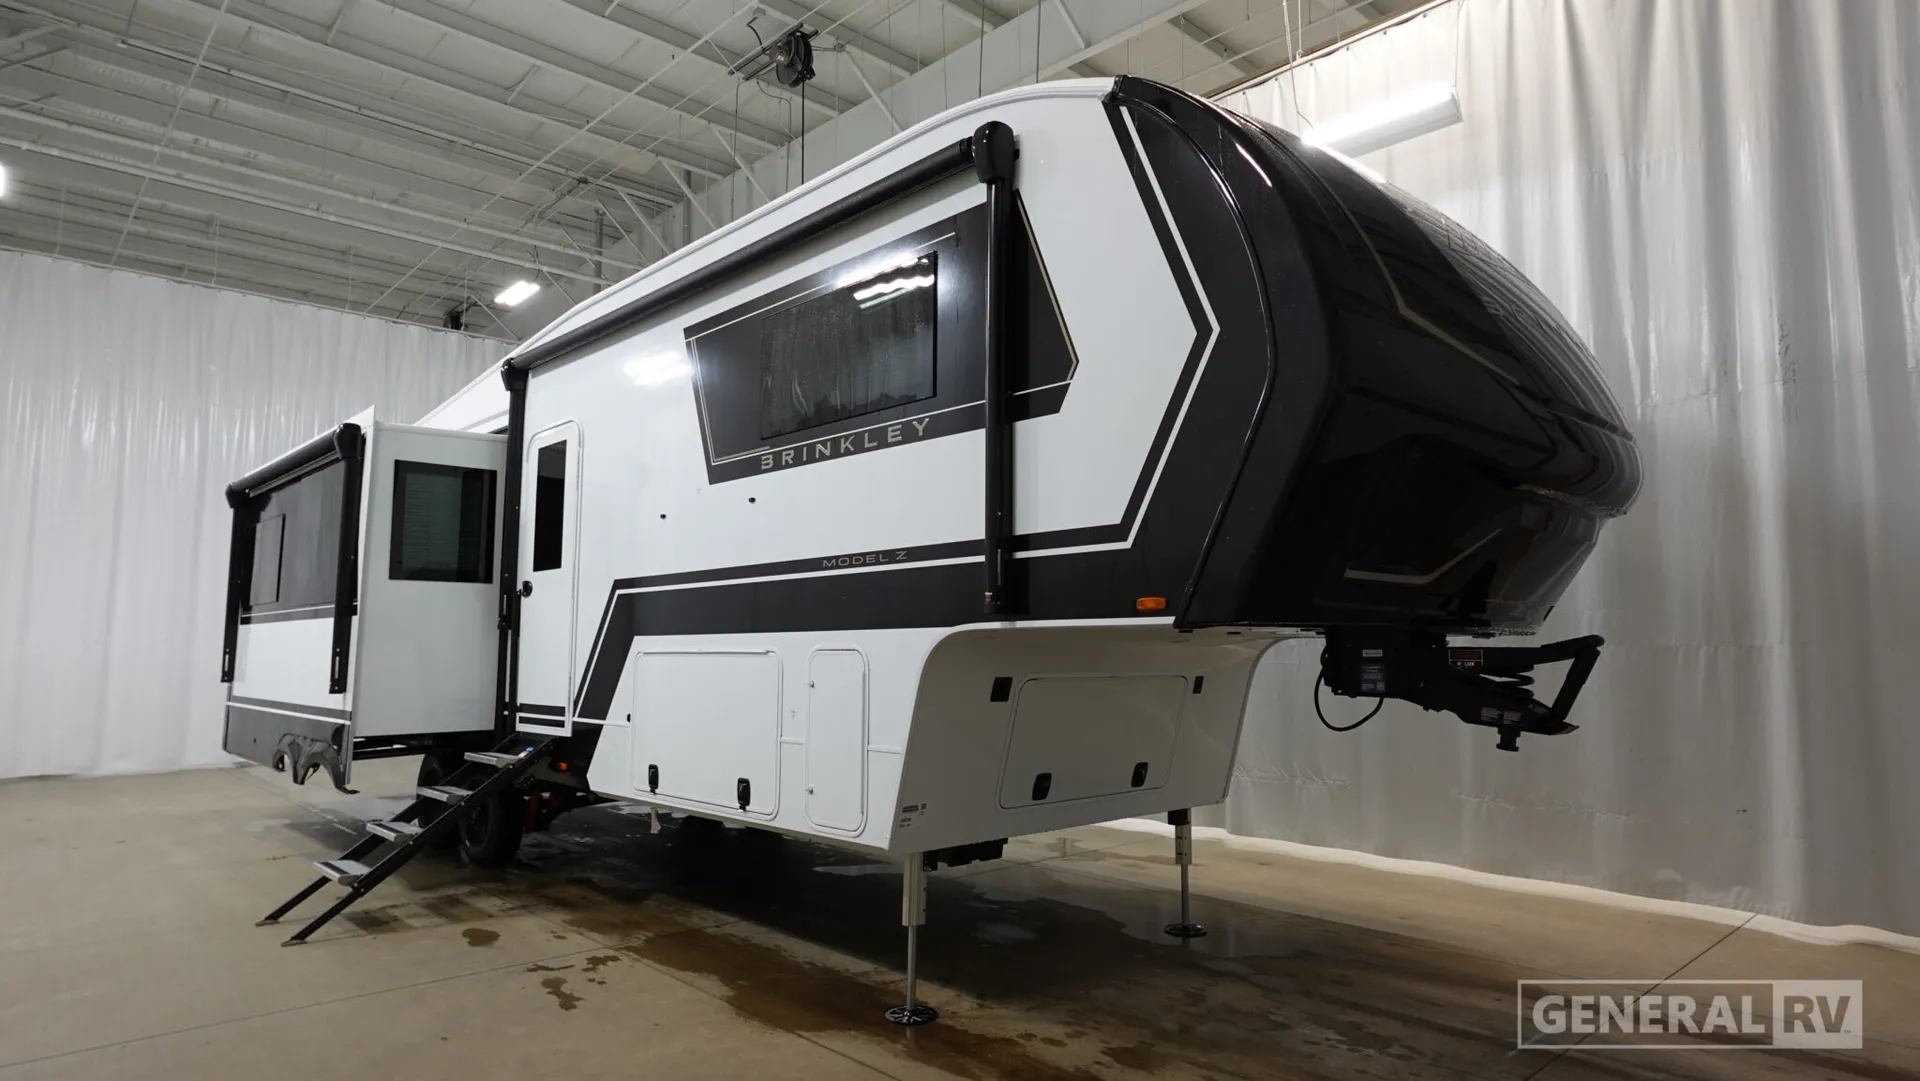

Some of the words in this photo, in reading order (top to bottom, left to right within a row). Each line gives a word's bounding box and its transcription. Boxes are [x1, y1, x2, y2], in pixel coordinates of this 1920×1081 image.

[761, 418, 930, 470] BRINKLEY
[822, 553, 889, 568] MODEL
[895, 550, 908, 561] Z
